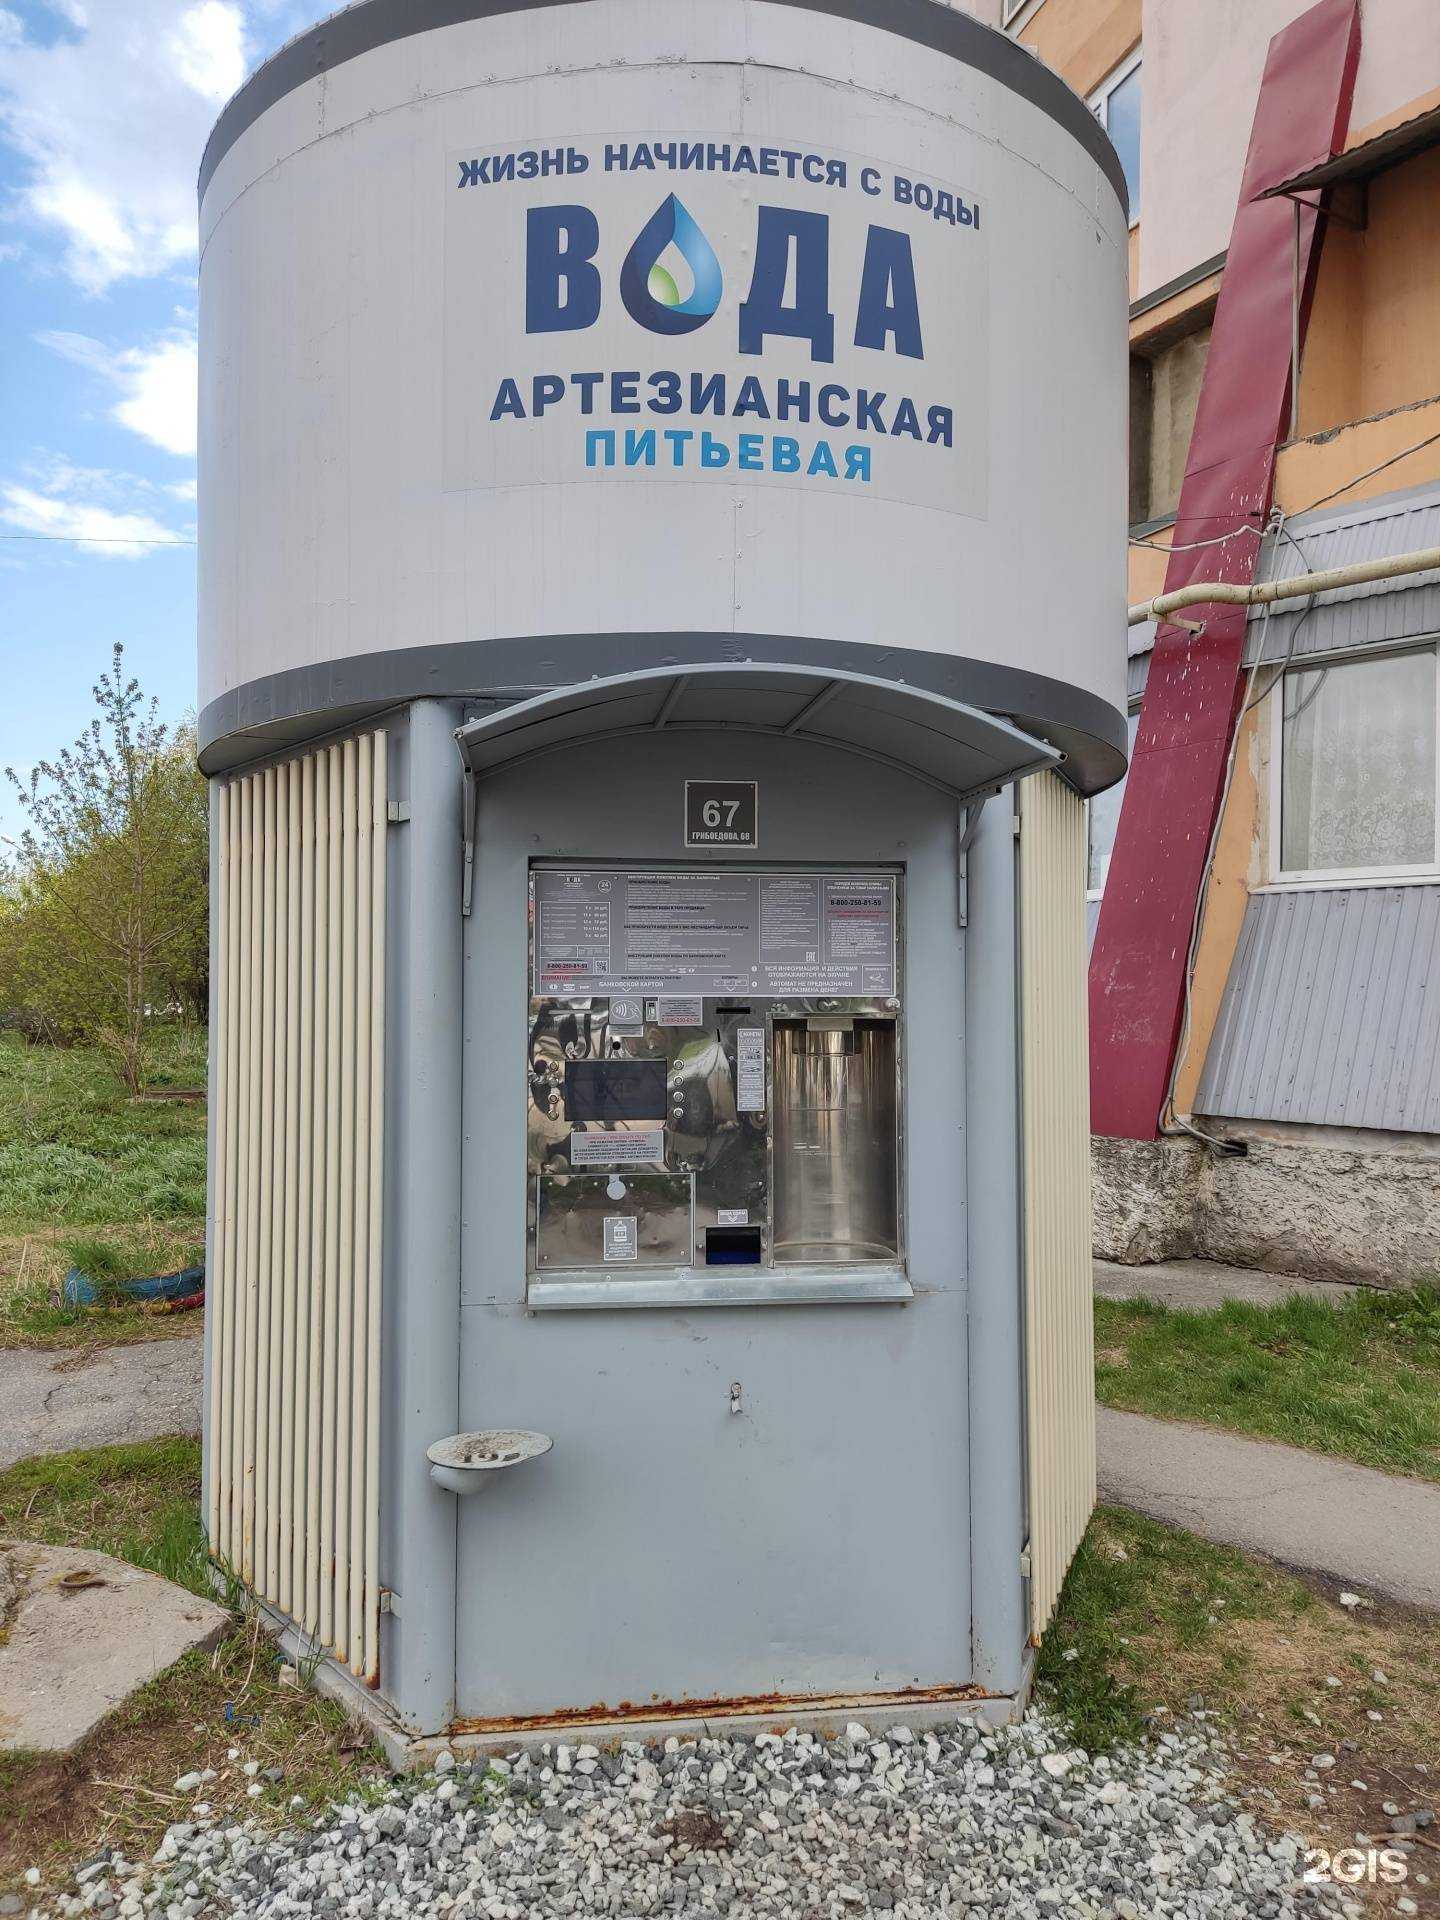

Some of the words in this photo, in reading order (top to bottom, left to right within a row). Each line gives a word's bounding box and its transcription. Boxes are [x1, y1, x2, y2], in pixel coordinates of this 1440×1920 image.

[457, 147, 590, 189] ЖИЗНЬ
[604, 143, 847, 189] НАЧИНАЕТСЯ
[860, 167, 882, 196] С
[893, 176, 981, 230] ВОДЫ
[525, 191, 925, 364] ВОДА
[489, 370, 954, 449] АРТЕЗИАНСКАЯ
[584, 429, 872, 482] ПИТЬЕВАЯ
[702, 799, 740, 827] 67
